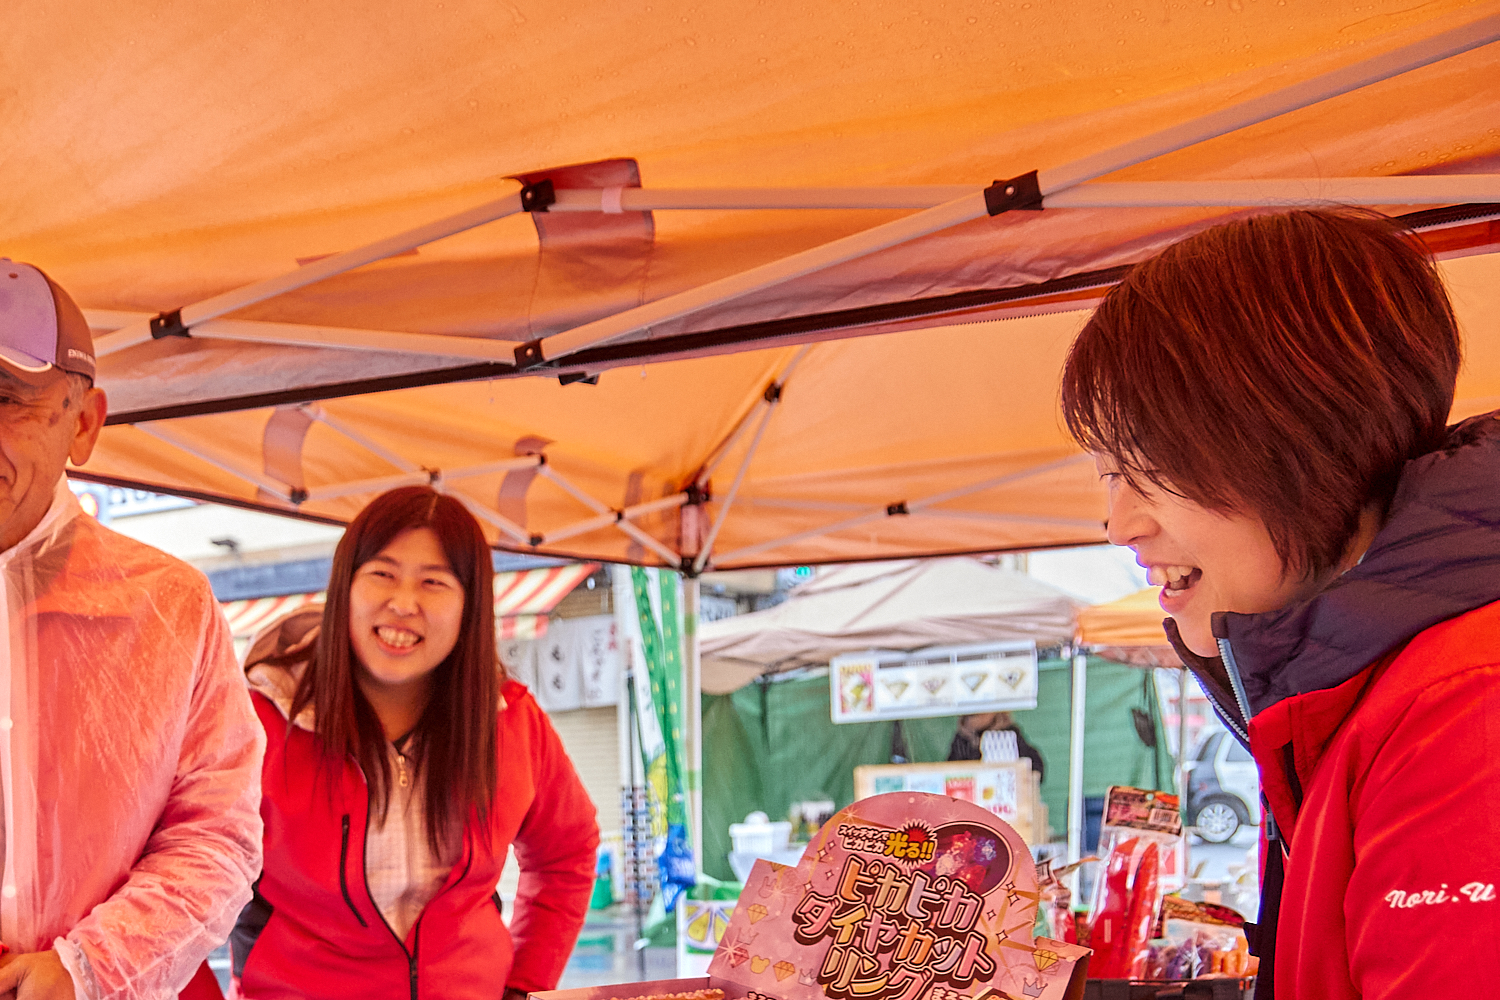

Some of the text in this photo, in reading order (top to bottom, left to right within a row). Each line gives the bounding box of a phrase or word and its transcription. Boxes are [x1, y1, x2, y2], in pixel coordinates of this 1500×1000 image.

[837, 855, 985, 932] ピカピカ
[795, 892, 995, 982] ダイヤカット
